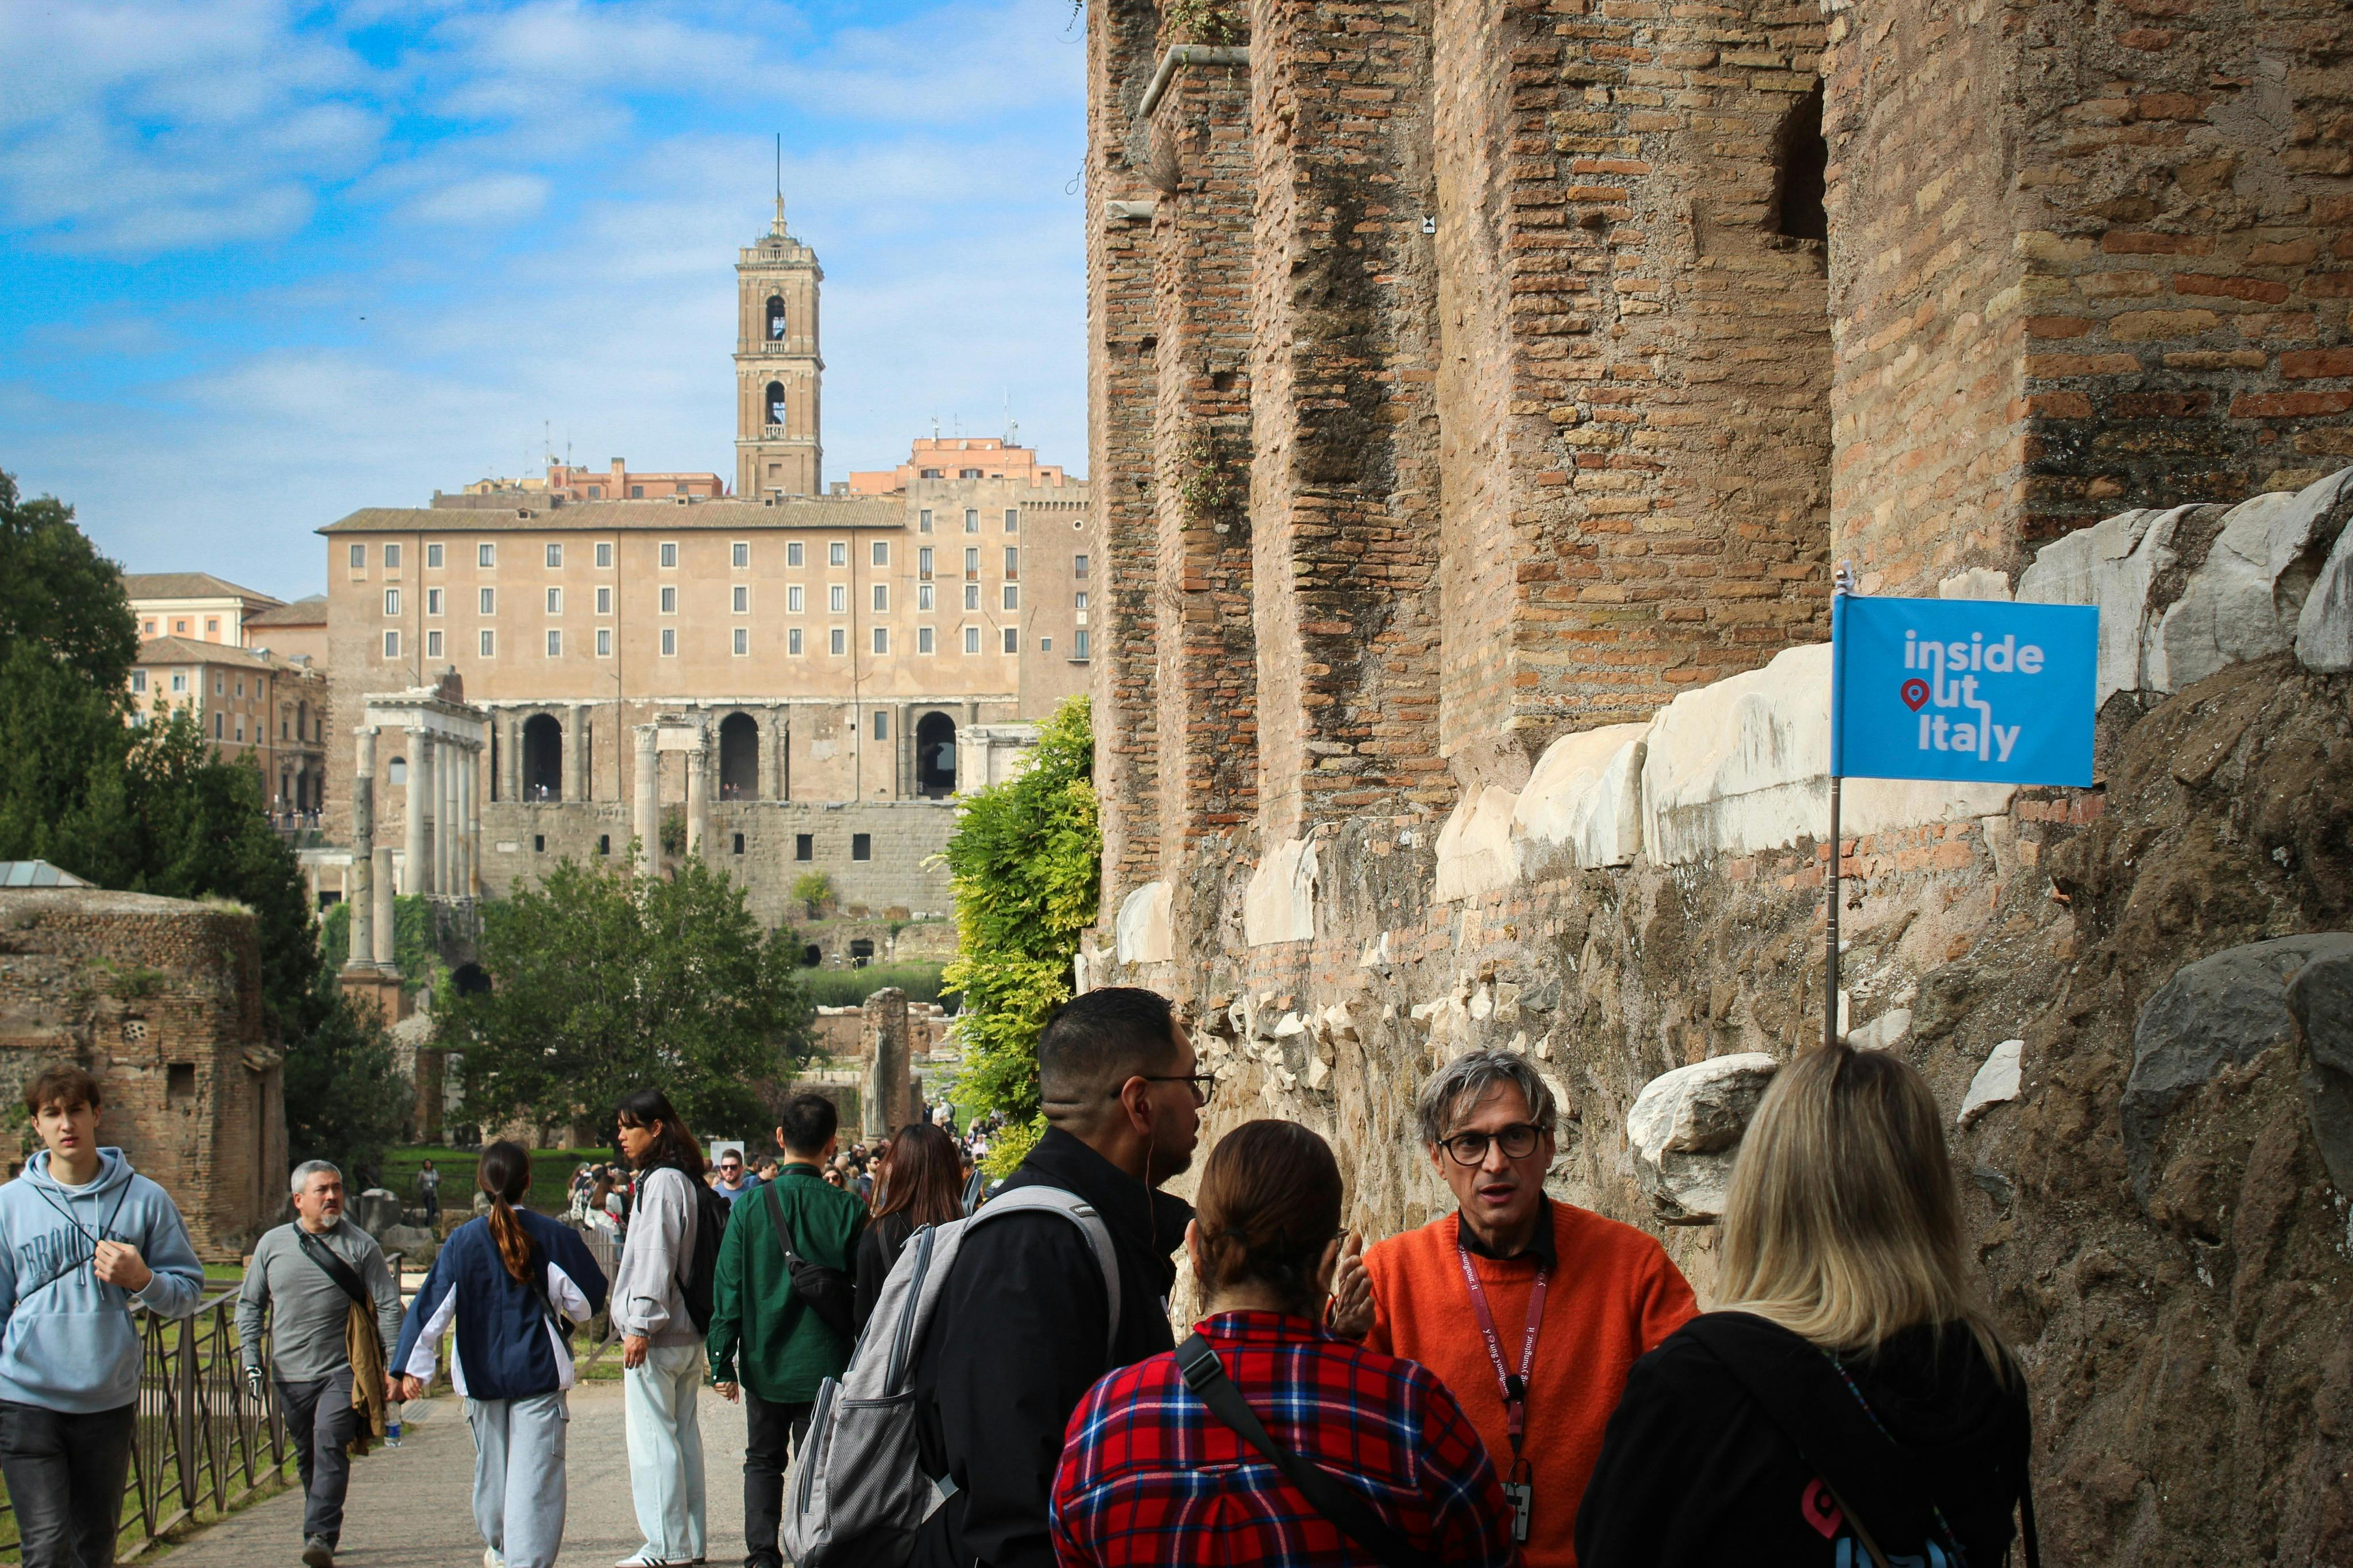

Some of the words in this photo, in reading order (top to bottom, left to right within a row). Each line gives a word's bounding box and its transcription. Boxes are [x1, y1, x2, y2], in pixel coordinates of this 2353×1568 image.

[1904, 629, 2044, 674] inside
[1919, 714, 2020, 762] Italy
[20, 1223, 133, 1280] BROOK
